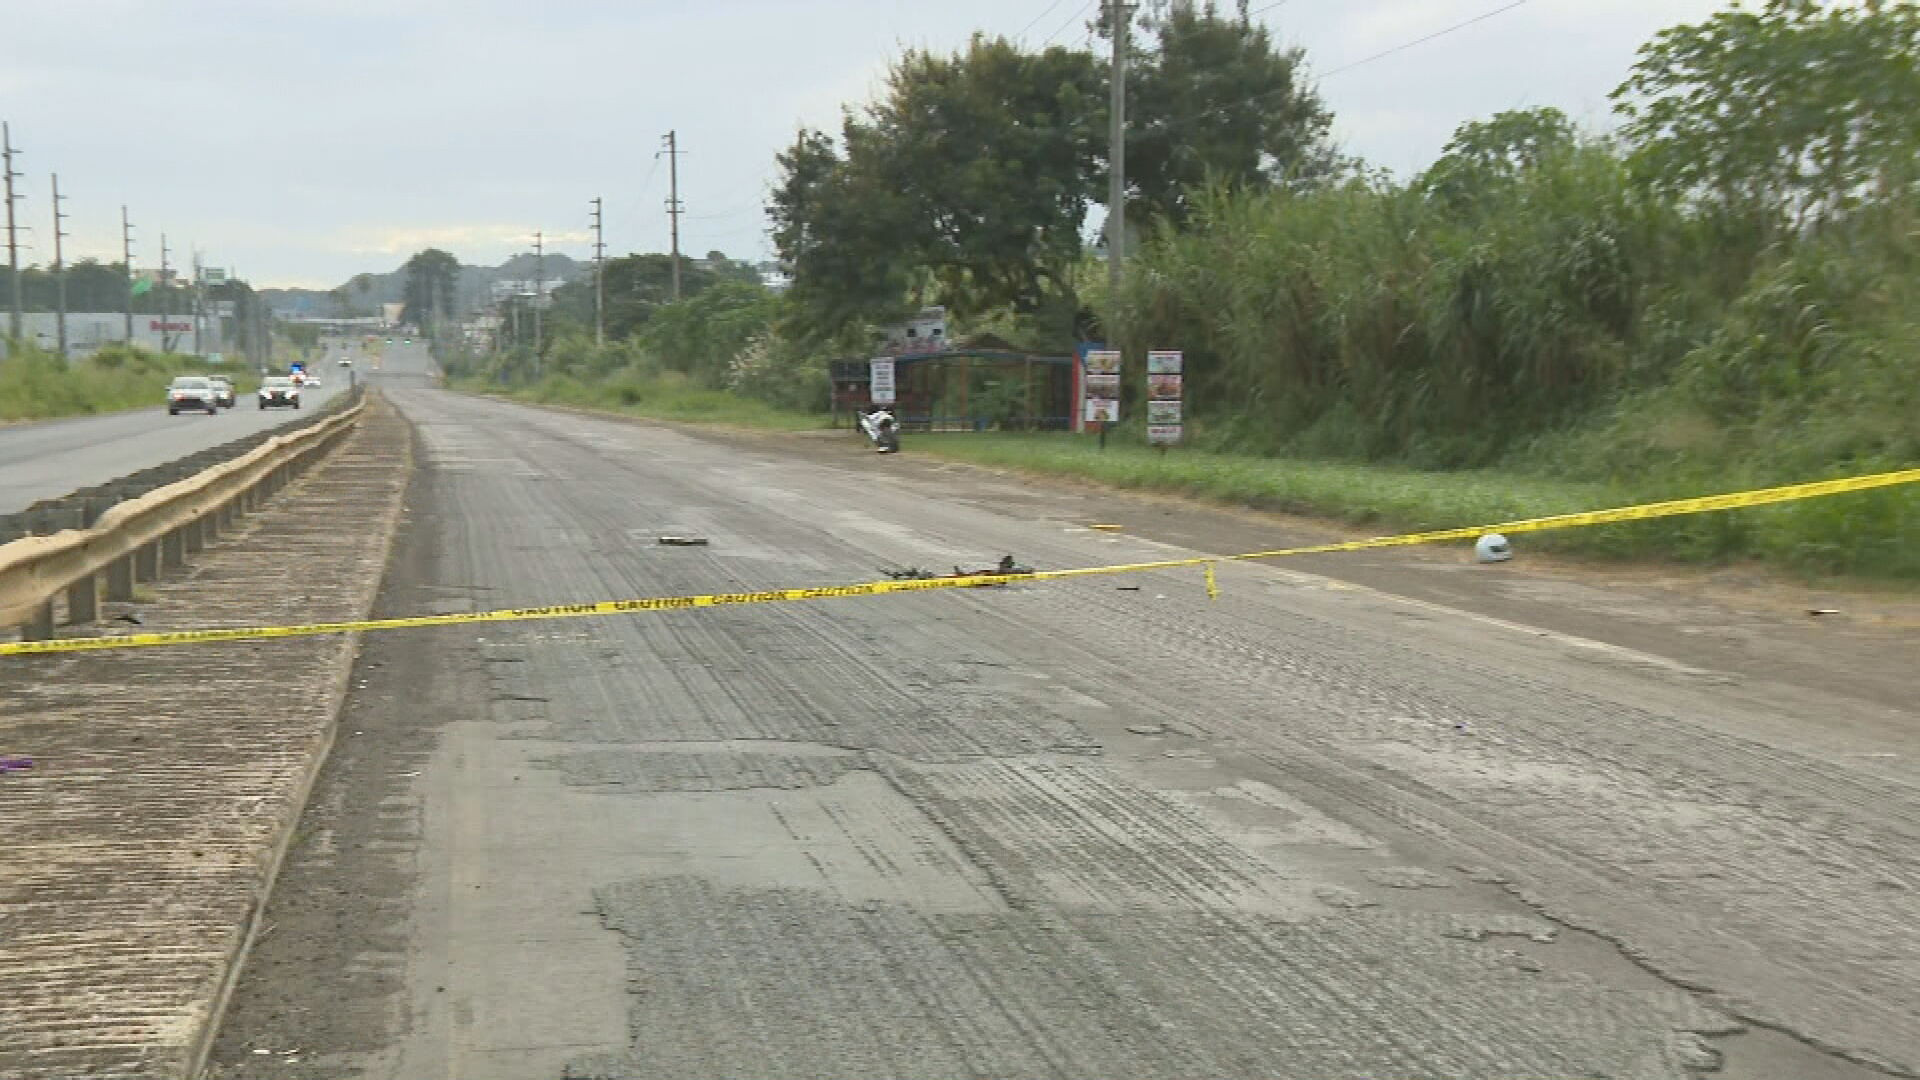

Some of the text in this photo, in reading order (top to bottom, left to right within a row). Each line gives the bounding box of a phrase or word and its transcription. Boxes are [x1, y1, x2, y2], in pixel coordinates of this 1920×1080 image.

[512, 604, 596, 616] CAUTION
[615, 597, 694, 611] CAUTION
[712, 592, 786, 604] CAUTION
[803, 585, 872, 598] CAUTION
